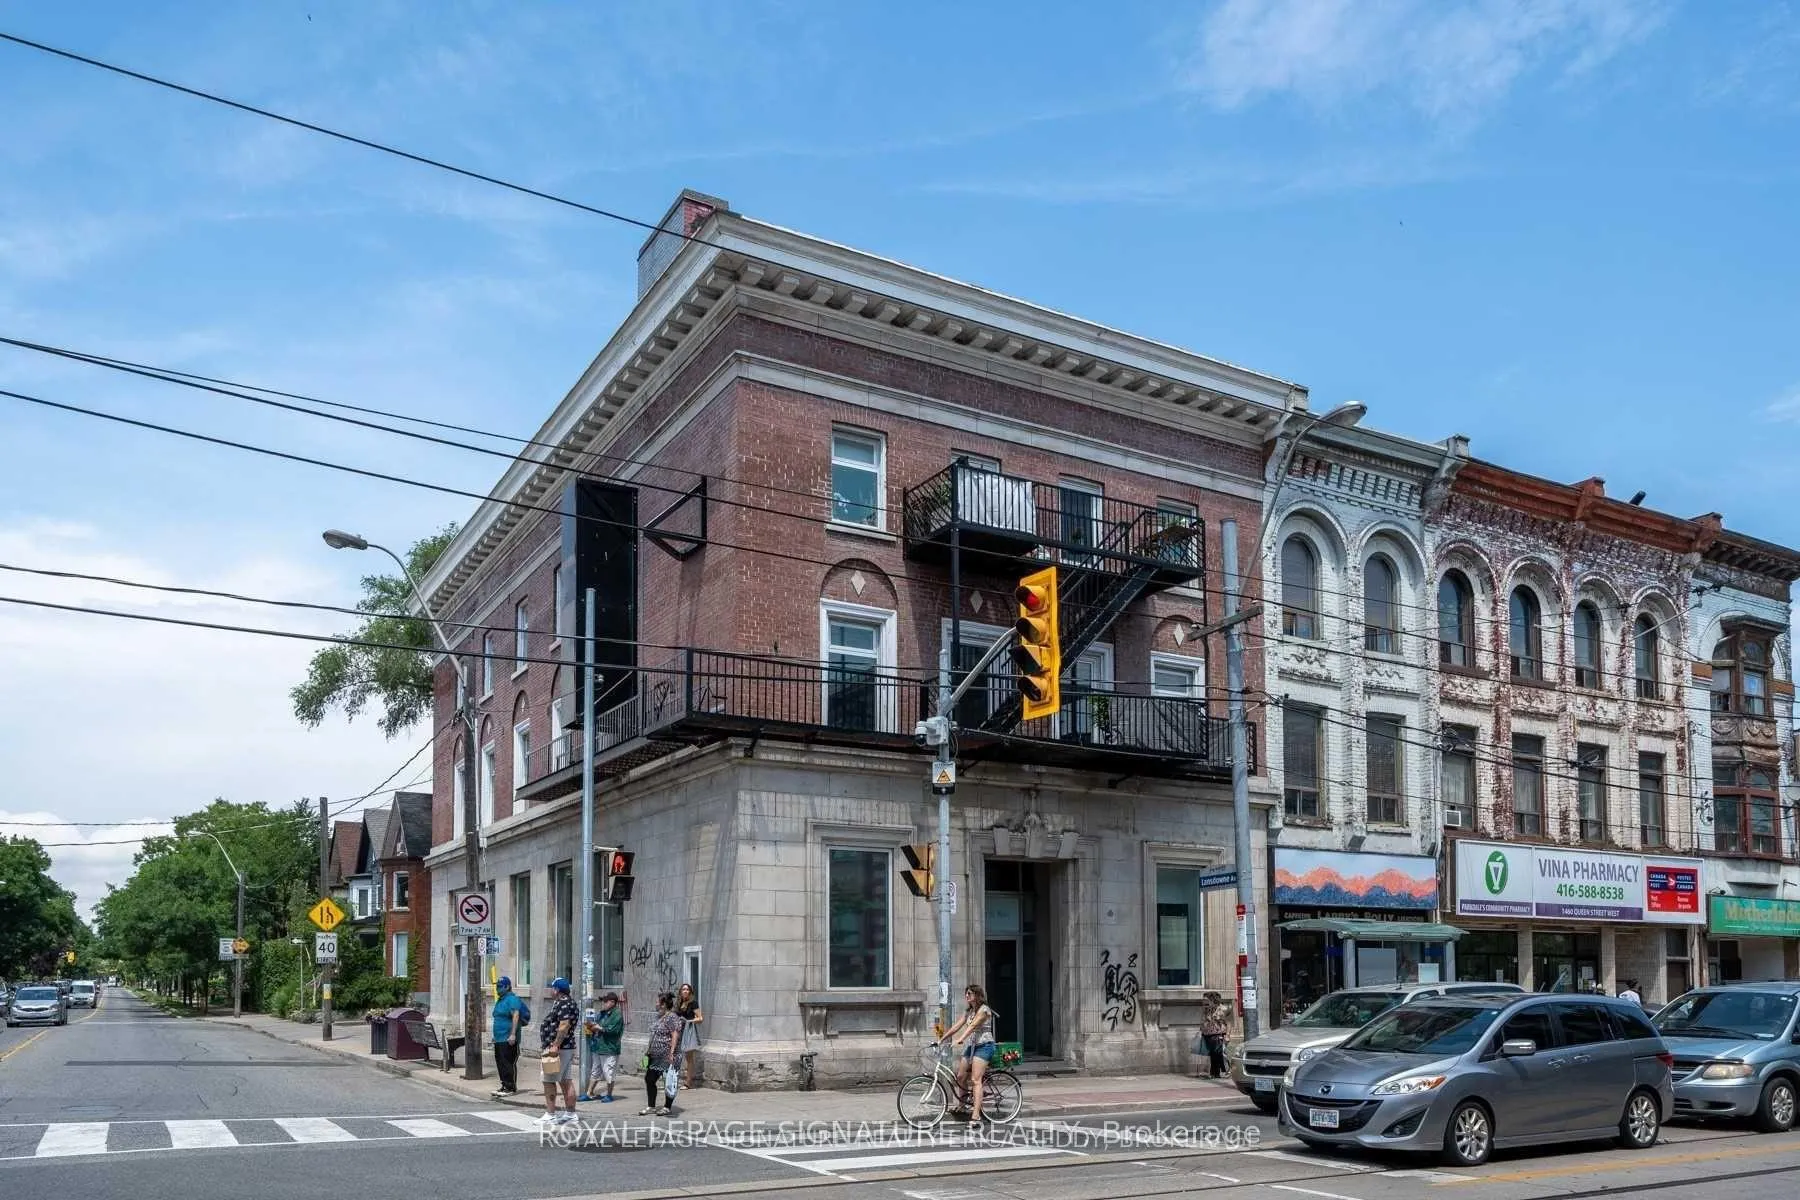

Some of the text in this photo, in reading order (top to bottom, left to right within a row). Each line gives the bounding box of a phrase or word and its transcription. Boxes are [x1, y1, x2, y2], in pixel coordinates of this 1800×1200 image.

[1539, 858, 1639, 882] VINA PHARMACY
[1573, 908, 1590, 916] QUEEN
[1590, 909, 1607, 917] STREET
[318, 941, 335, 954] 40
